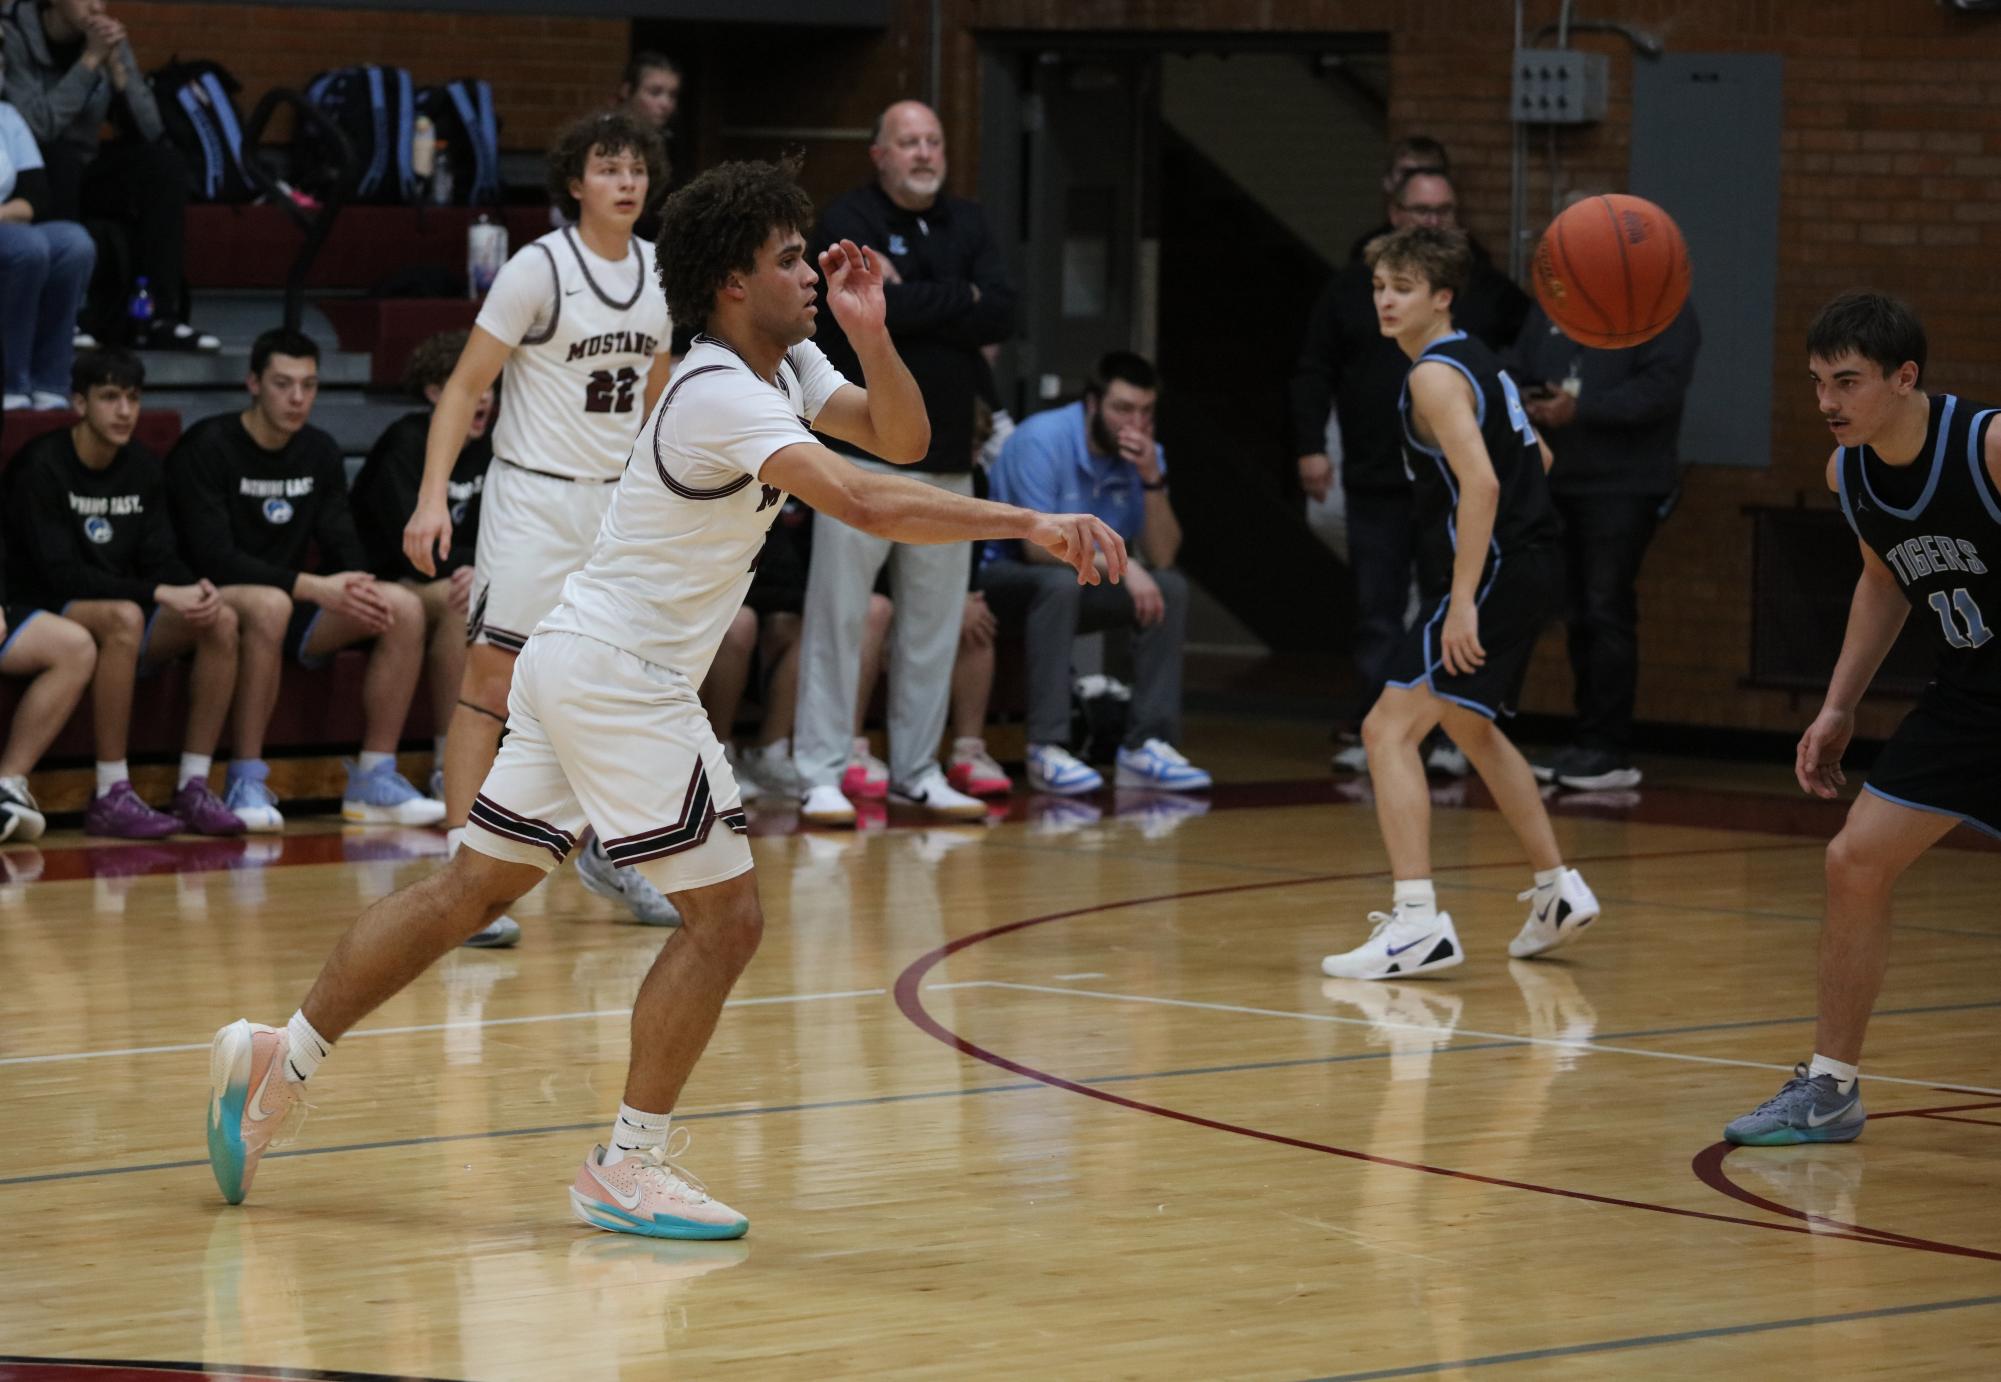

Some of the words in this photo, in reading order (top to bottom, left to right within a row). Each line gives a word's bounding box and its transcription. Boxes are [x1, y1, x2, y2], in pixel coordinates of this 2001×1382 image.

[565, 330, 658, 363] MUSTANG
[584, 366, 640, 413] 22
[1886, 535, 1988, 587] TIGERS
[1928, 587, 1994, 649] 11
